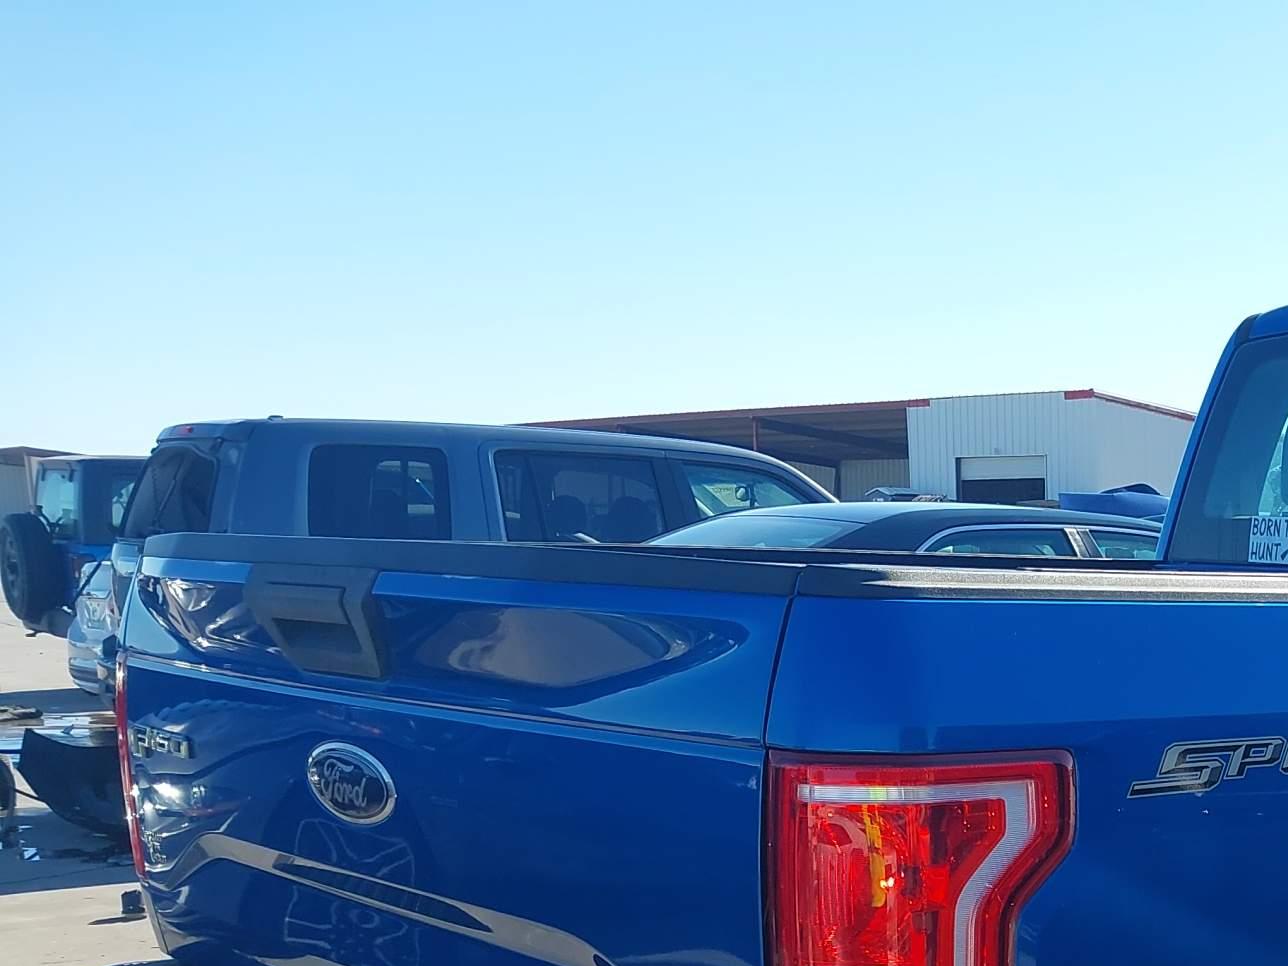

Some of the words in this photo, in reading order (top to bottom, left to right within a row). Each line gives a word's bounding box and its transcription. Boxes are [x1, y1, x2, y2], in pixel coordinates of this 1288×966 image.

[1252, 518, 1281, 537] BORN
[1250, 542, 1281, 561] HUNT
[320, 758, 368, 808] Ford
